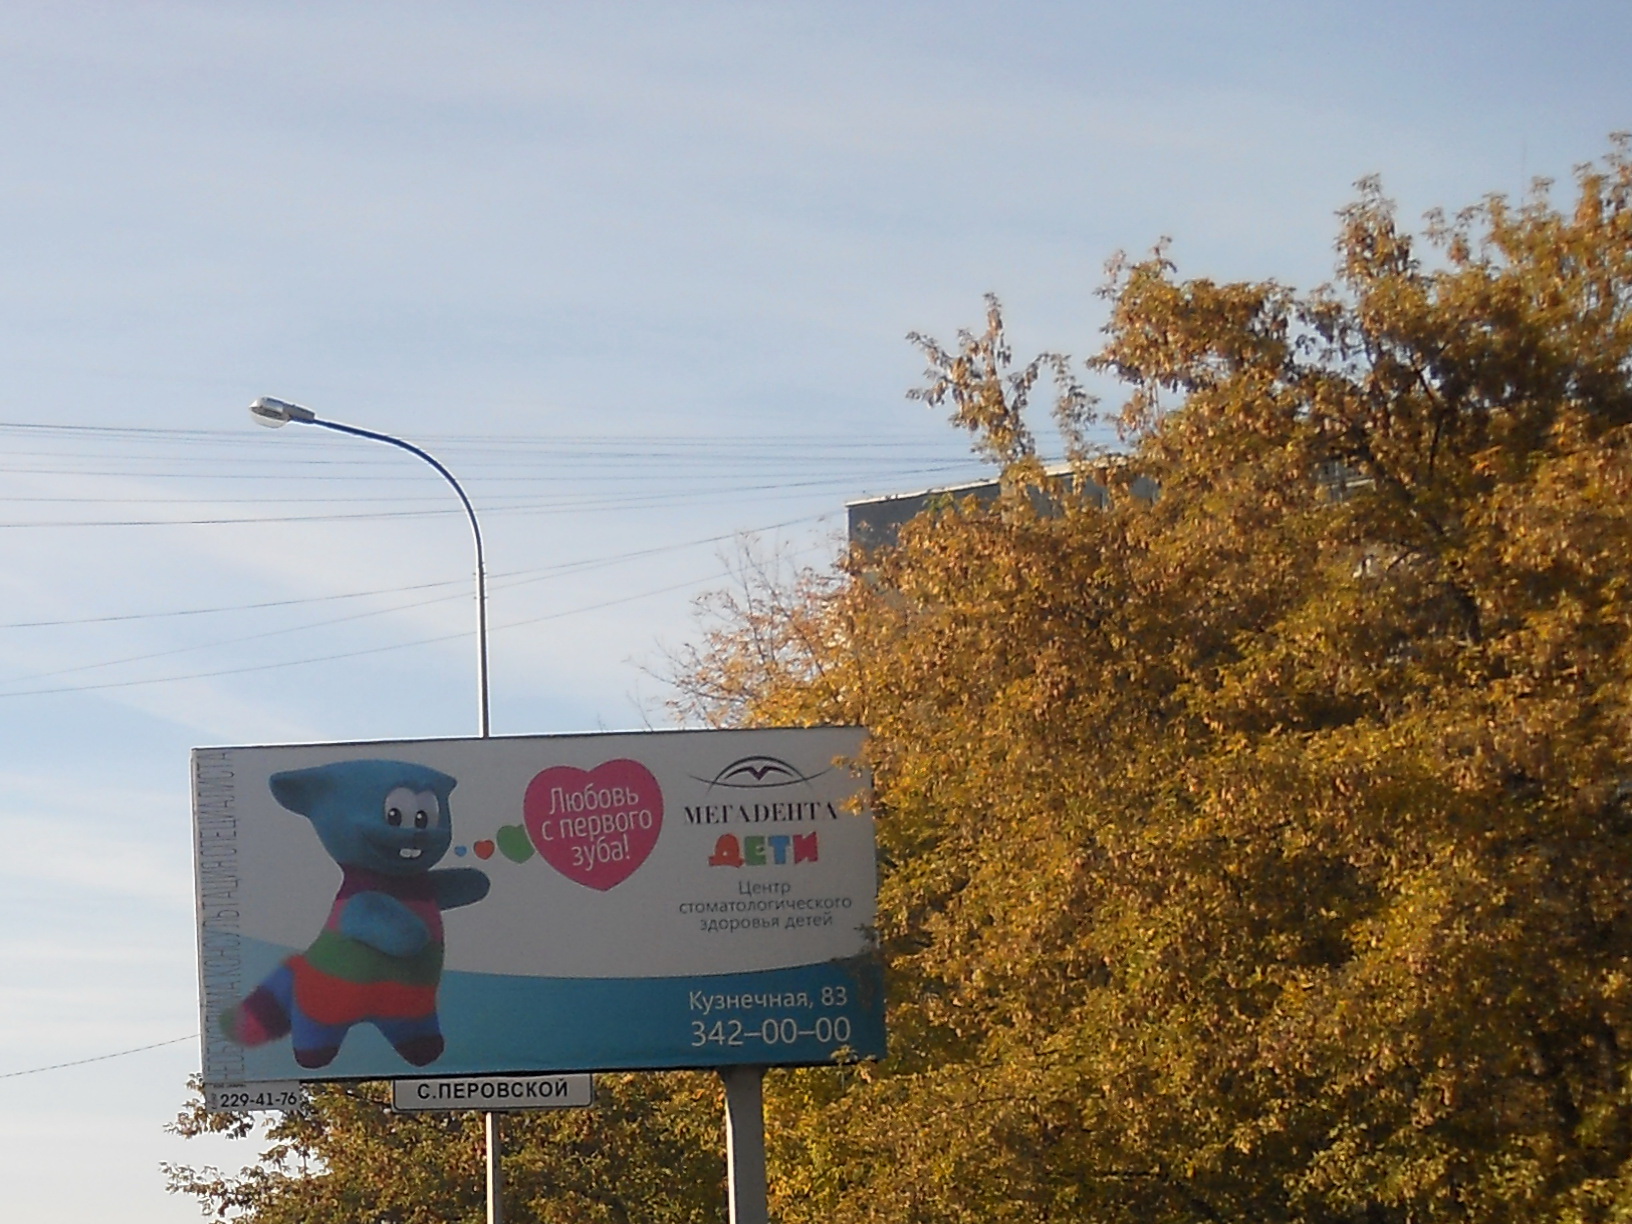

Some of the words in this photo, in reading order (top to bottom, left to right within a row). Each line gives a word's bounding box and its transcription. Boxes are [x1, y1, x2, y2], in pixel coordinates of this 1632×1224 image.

[549, 782, 639, 815] Любовь
[541, 821, 554, 841] с
[559, 809, 653, 841] первого
[571, 833, 631, 871] зуба!
[708, 831, 819, 868] ДЕТИ
[738, 881, 792, 896] Центр
[679, 897, 853, 915] стоматологического
[700, 918, 780, 933] здоровья
[784, 911, 834, 930] детей
[689, 990, 815, 1015] Кузнечная,
[821, 986, 848, 1006] 83
[690, 1016, 852, 1047] 342-00-00
[220, 1092, 298, 1108] 229-41-76
[417, 1077, 569, 1100] С.ПЕРОВСКОЙ
